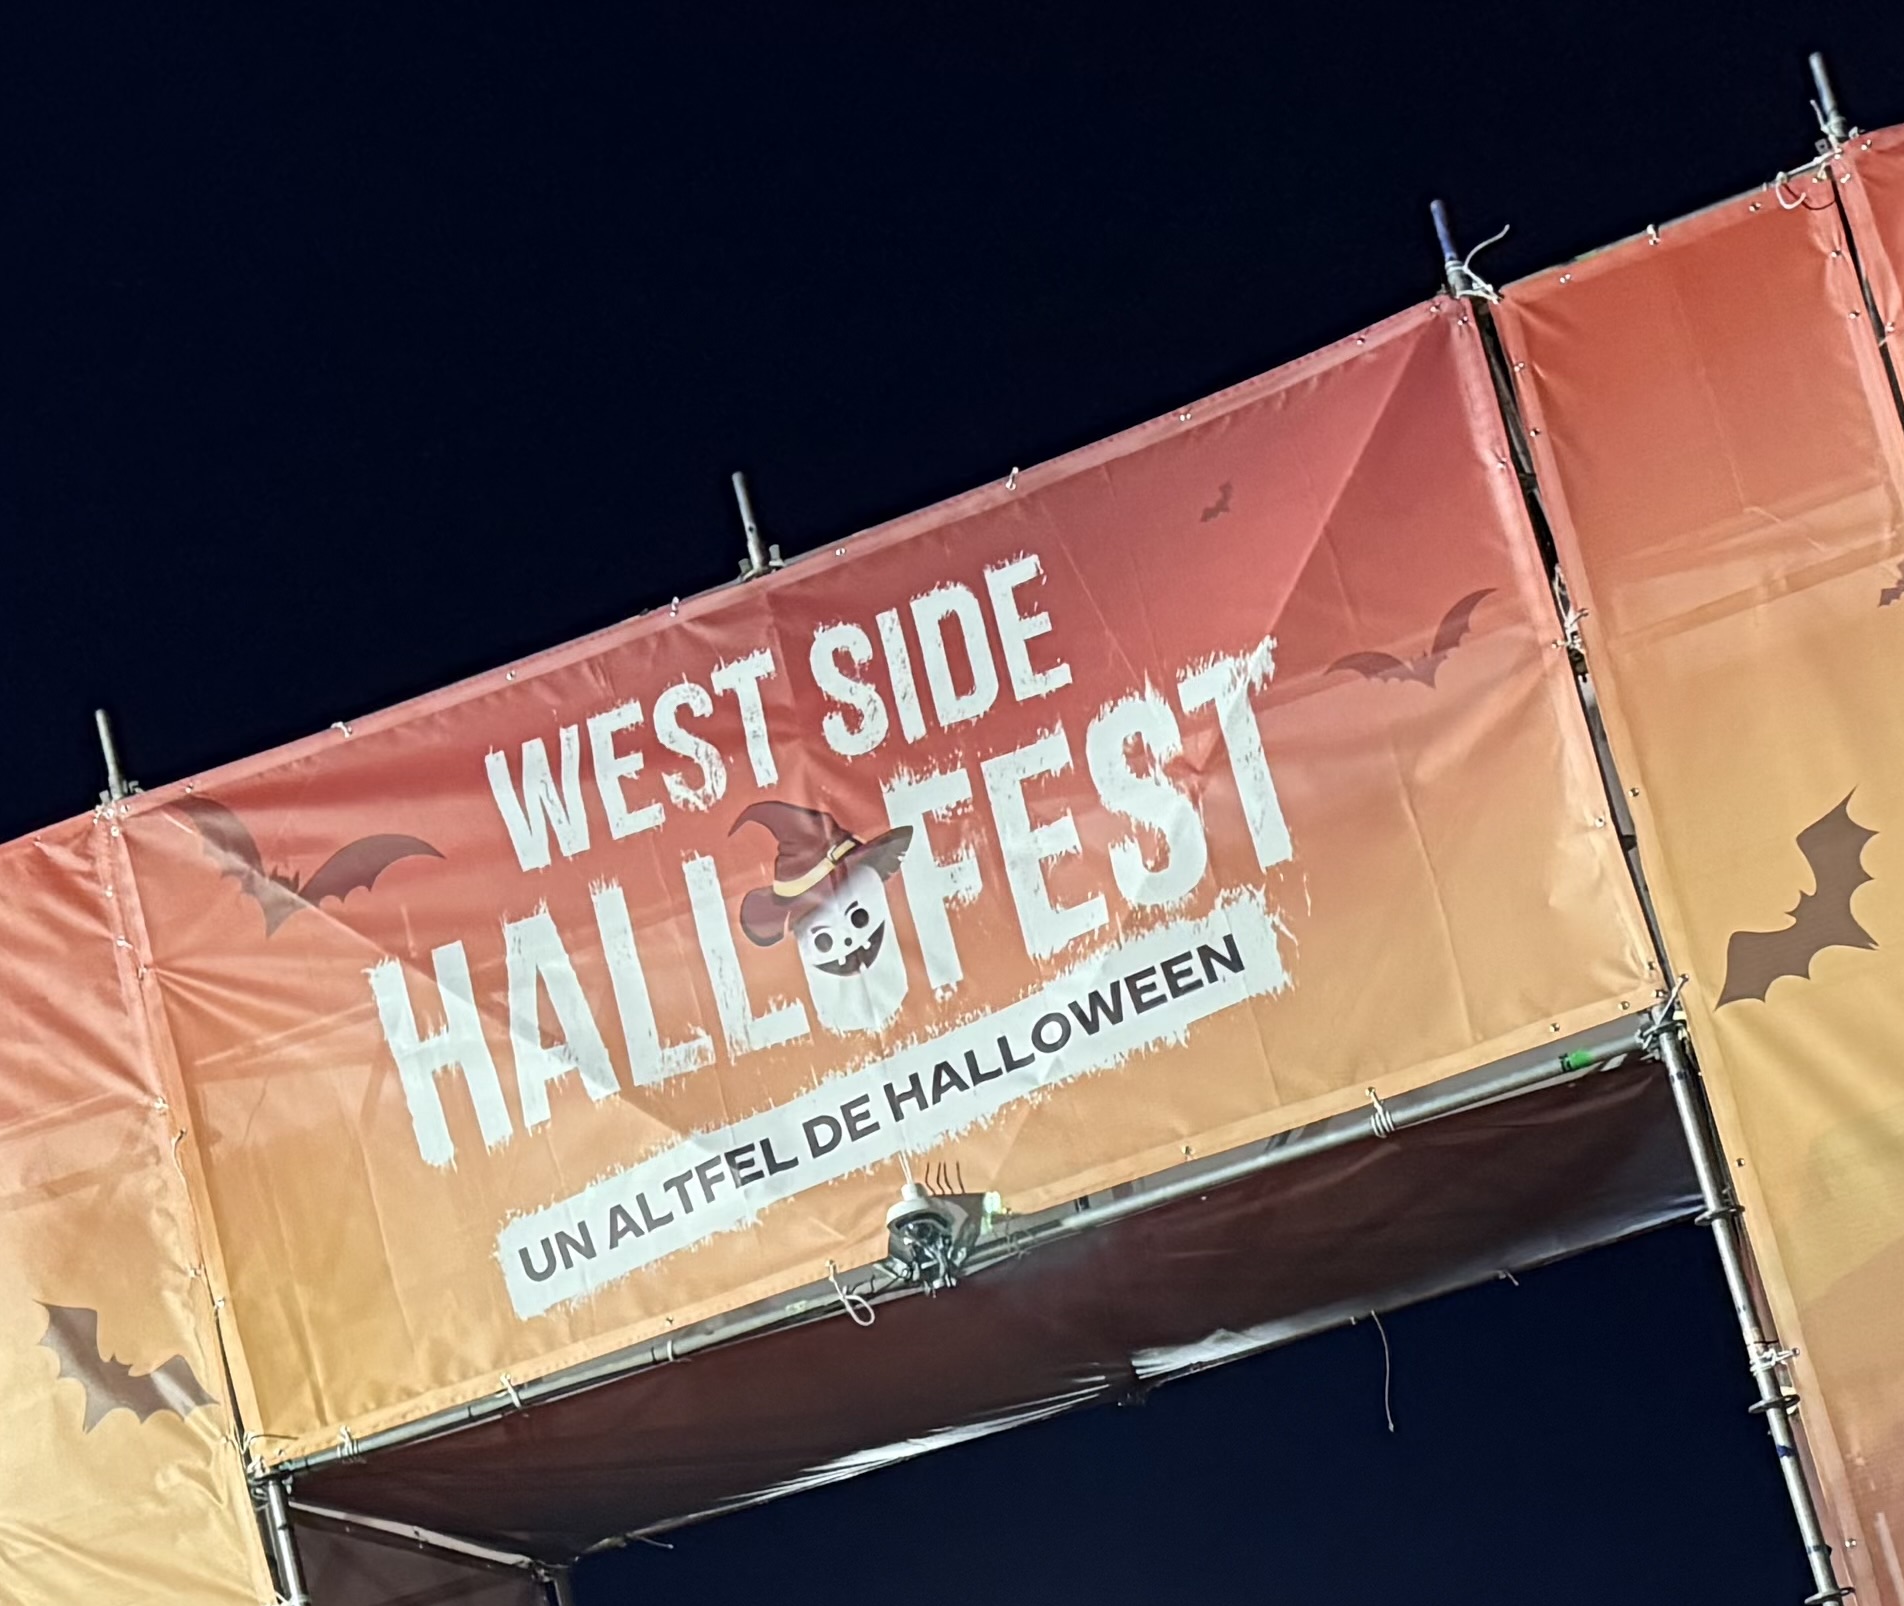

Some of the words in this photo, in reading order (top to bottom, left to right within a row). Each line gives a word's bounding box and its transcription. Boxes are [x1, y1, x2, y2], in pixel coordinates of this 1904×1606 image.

[484, 648, 778, 871] WEST
[808, 553, 1073, 760] SIDE
[518, 1221, 598, 1283] UN
[607, 1137, 799, 1254] ALTFEL
[806, 1091, 882, 1161] DE
[883, 933, 1247, 1122] HALLOWEEN
